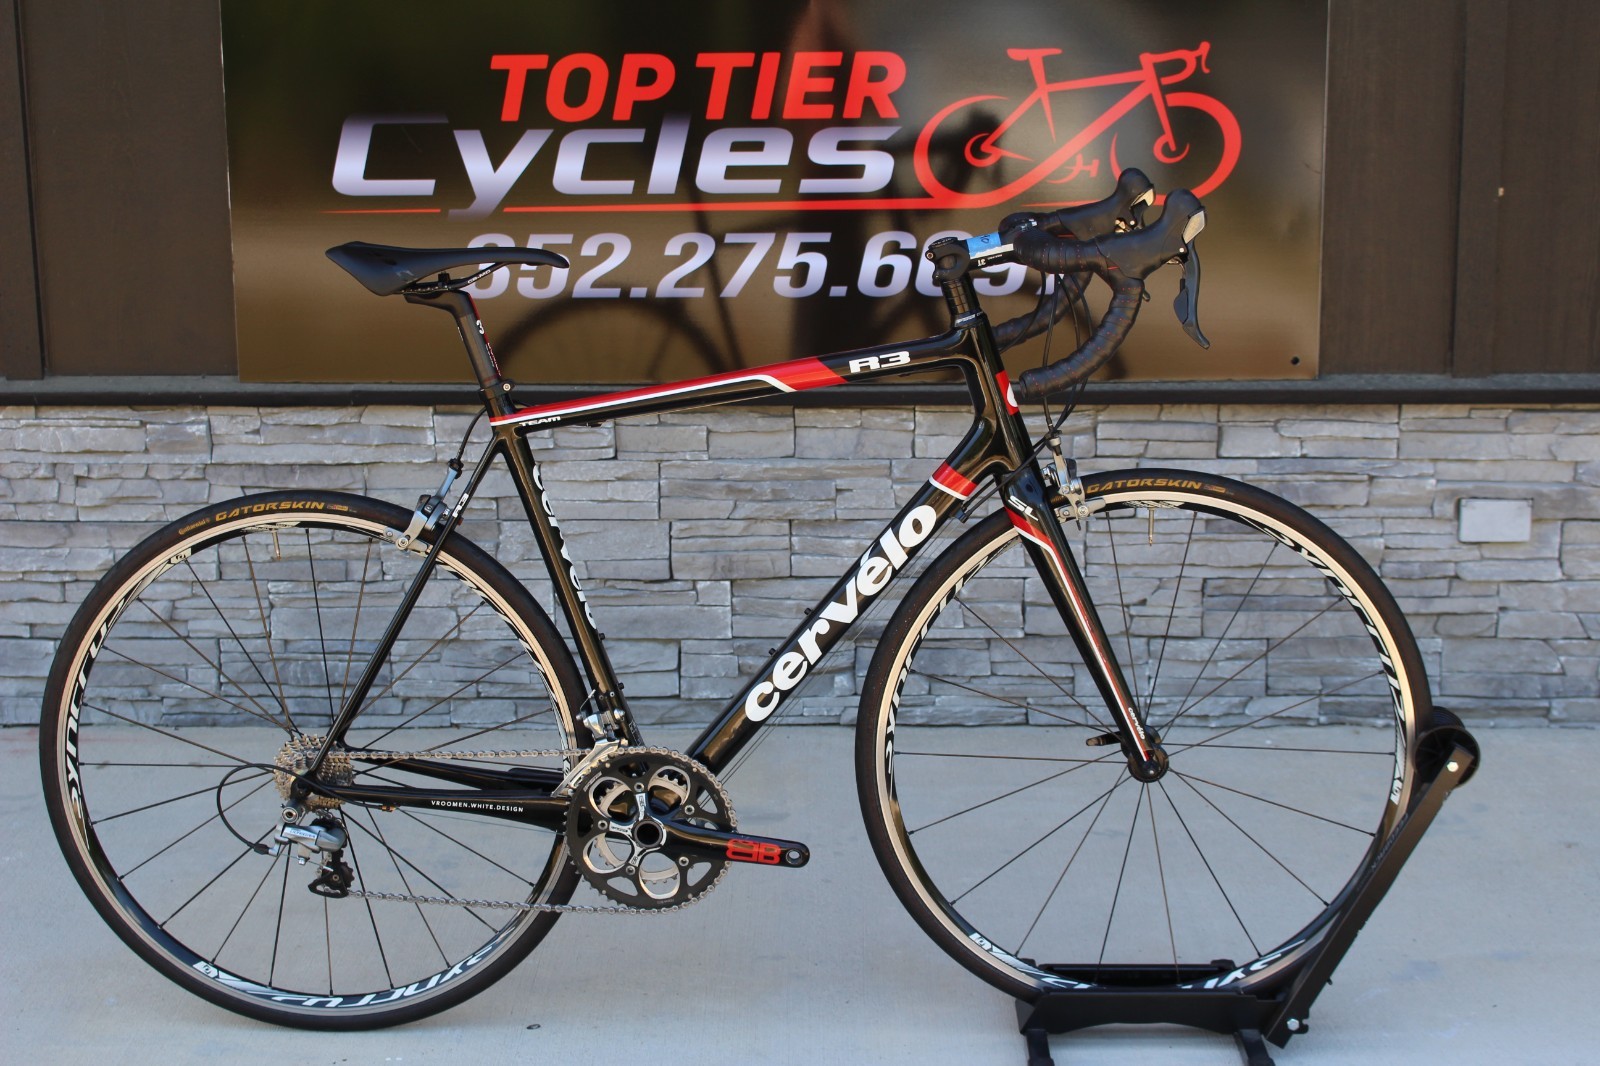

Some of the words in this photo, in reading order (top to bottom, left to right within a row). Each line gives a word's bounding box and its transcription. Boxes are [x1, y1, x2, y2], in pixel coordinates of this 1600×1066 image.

[490, 53, 676, 122] TOP
[695, 51, 907, 120] TIER
[332, 112, 903, 222] Cycles
[849, 351, 911, 374] R3
[519, 415, 561, 427] TEAM
[1086, 478, 1202, 494] GATORSKIN
[215, 501, 325, 522] GATORSKIN
[1008, 495, 1039, 522] SL
[745, 505, 937, 722] cervélo
[431, 800, 524, 813] VROOMEN.WHITE.DESIGN
